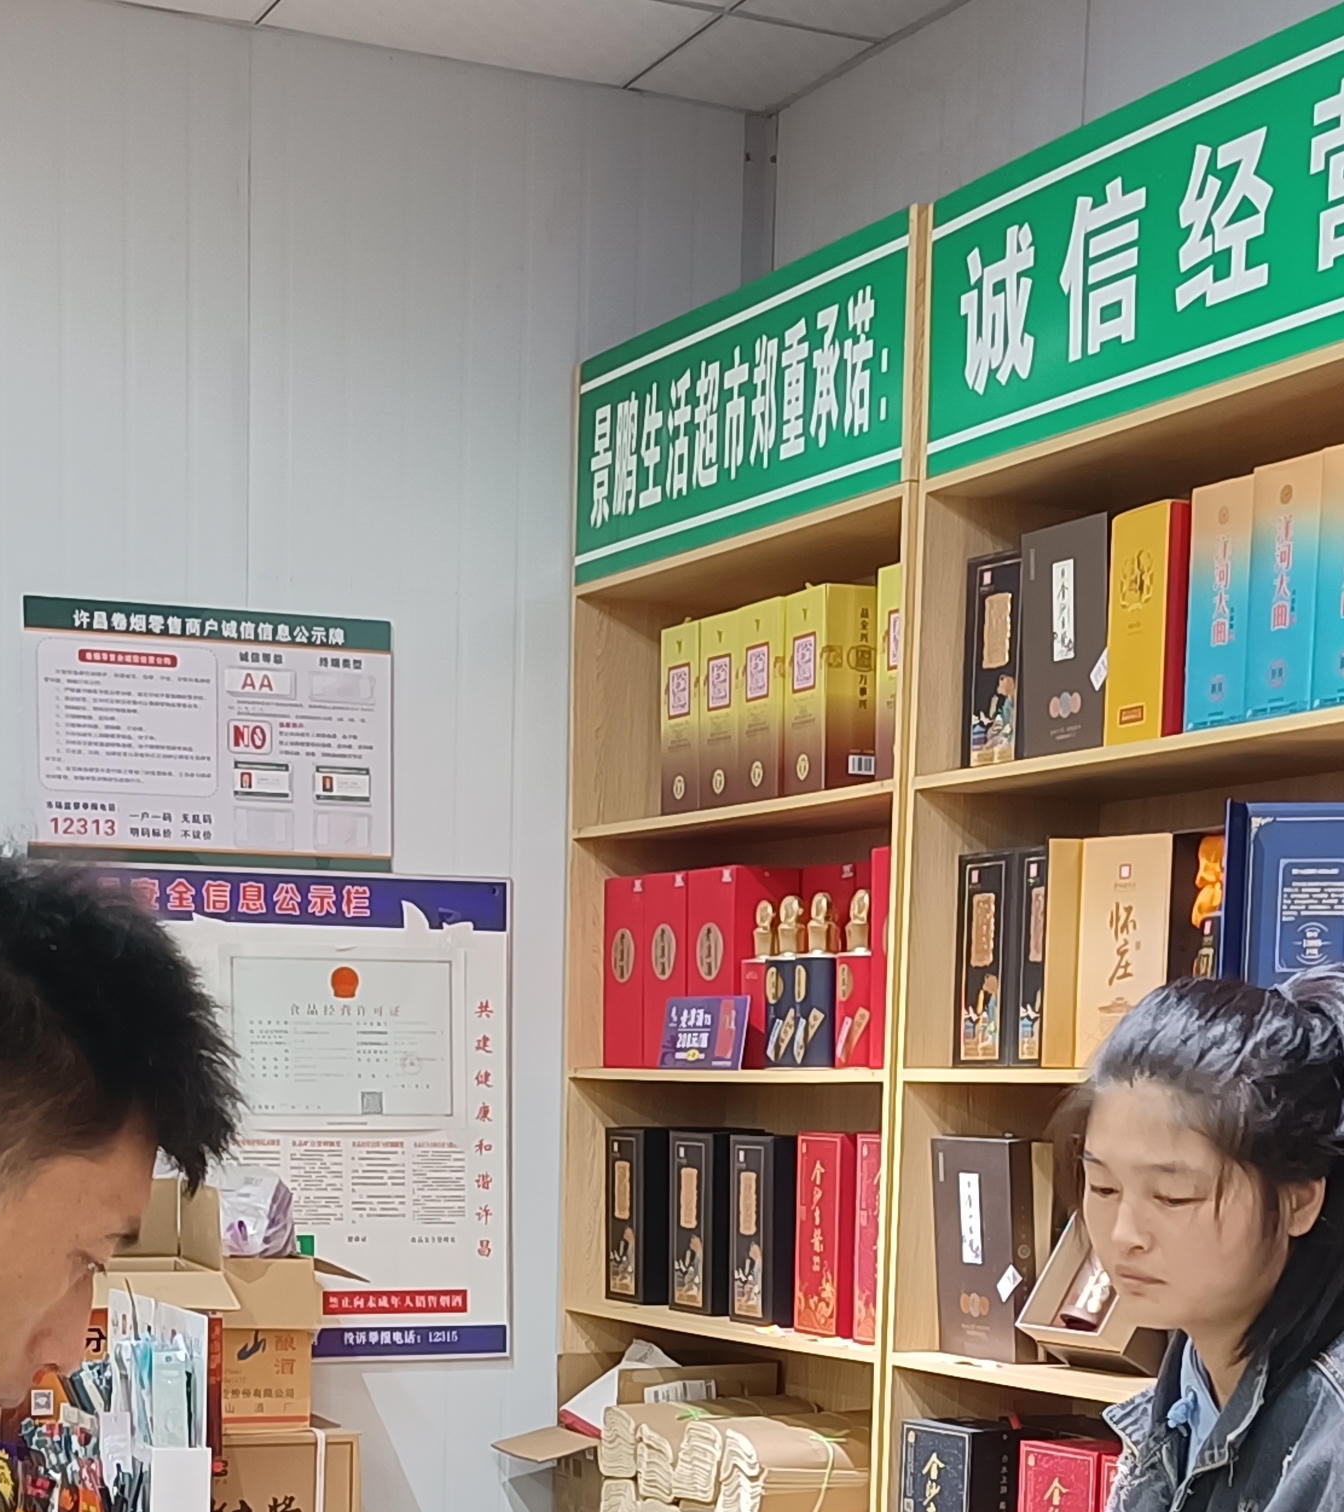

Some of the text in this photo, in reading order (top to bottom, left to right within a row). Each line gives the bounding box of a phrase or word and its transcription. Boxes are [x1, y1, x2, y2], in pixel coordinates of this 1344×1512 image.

[590, 285, 889, 529] 景鹏生活超市郑重承诺：
[1270, 514, 1296, 631] 洋河大曲
[240, 672, 274, 692] AA
[49, 816, 117, 837] 12313
[473, 998, 495, 1259] 共建健康和谐许昌
